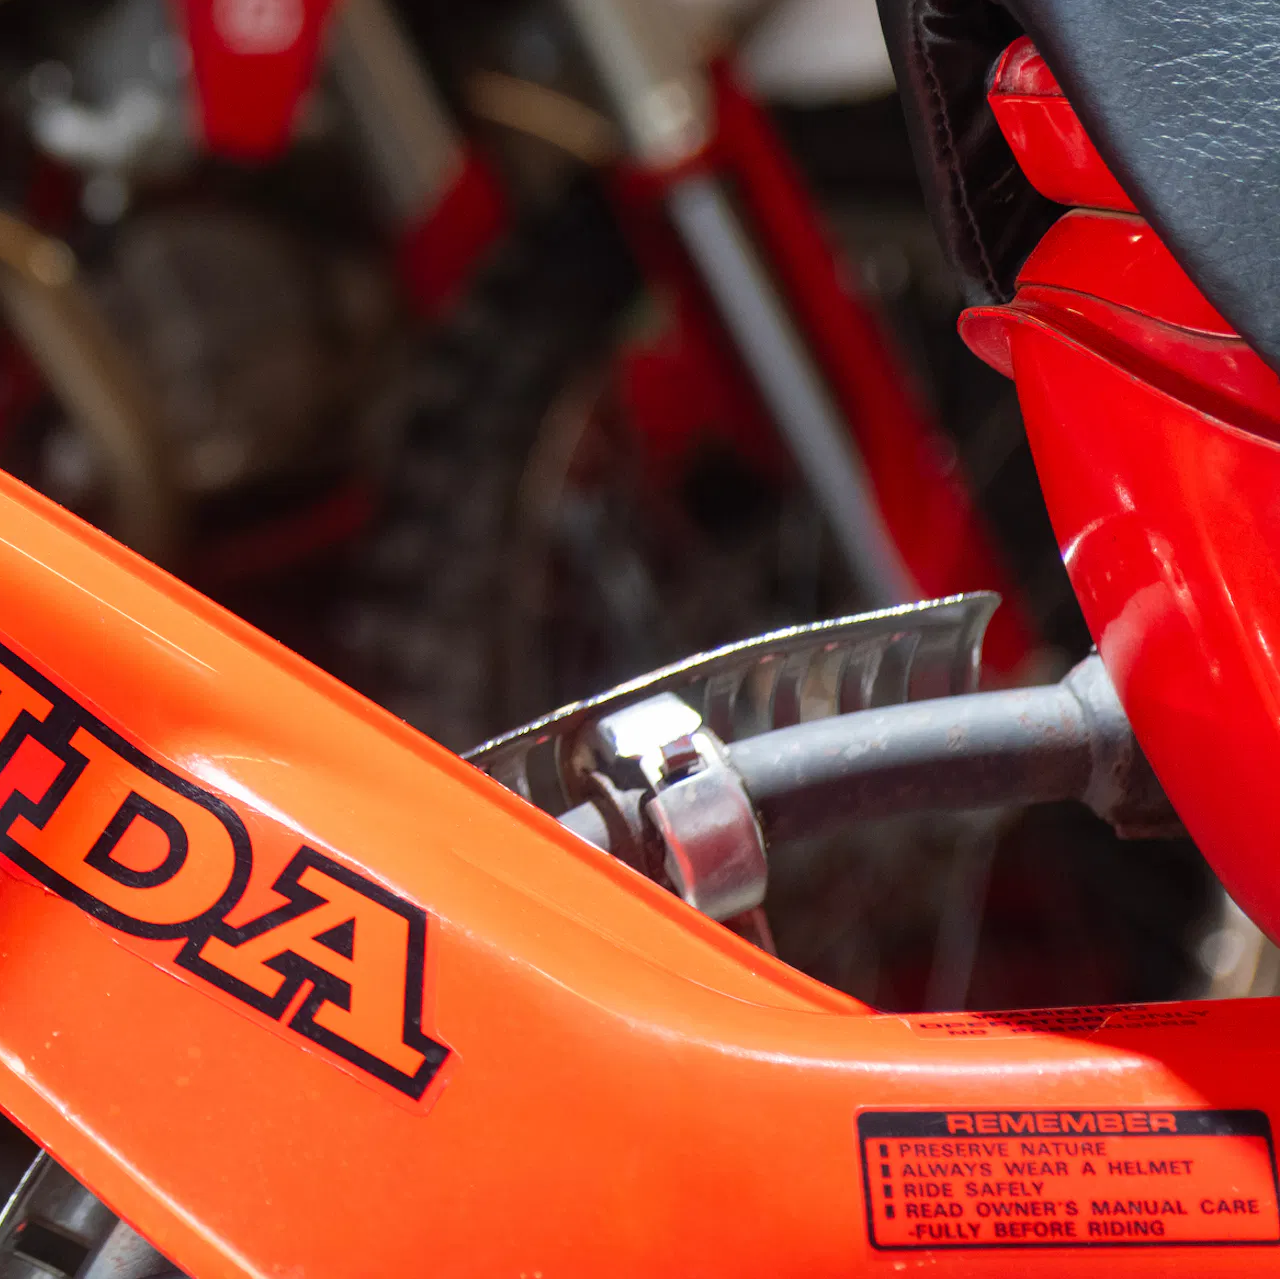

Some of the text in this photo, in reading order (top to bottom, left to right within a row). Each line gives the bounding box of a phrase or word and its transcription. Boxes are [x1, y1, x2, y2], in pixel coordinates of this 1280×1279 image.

[920, 1010, 1209, 1029] OPERATOR ONLY
[971, 1005, 1147, 1019] WARNING
[946, 1113, 1178, 1134] REMEMBER
[899, 1141, 1107, 1157] PRESERVE NATURE
[902, 1160, 1194, 1177] ALWAYS WEAR A HELMET
[903, 1182, 1044, 1197] RIDE SAFELY
[906, 1199, 1260, 1218] READ OWNER'S MANUAL CARE
[994, 1221, 1078, 1238] BEFORE
[1087, 1220, 1165, 1236] RIDING
